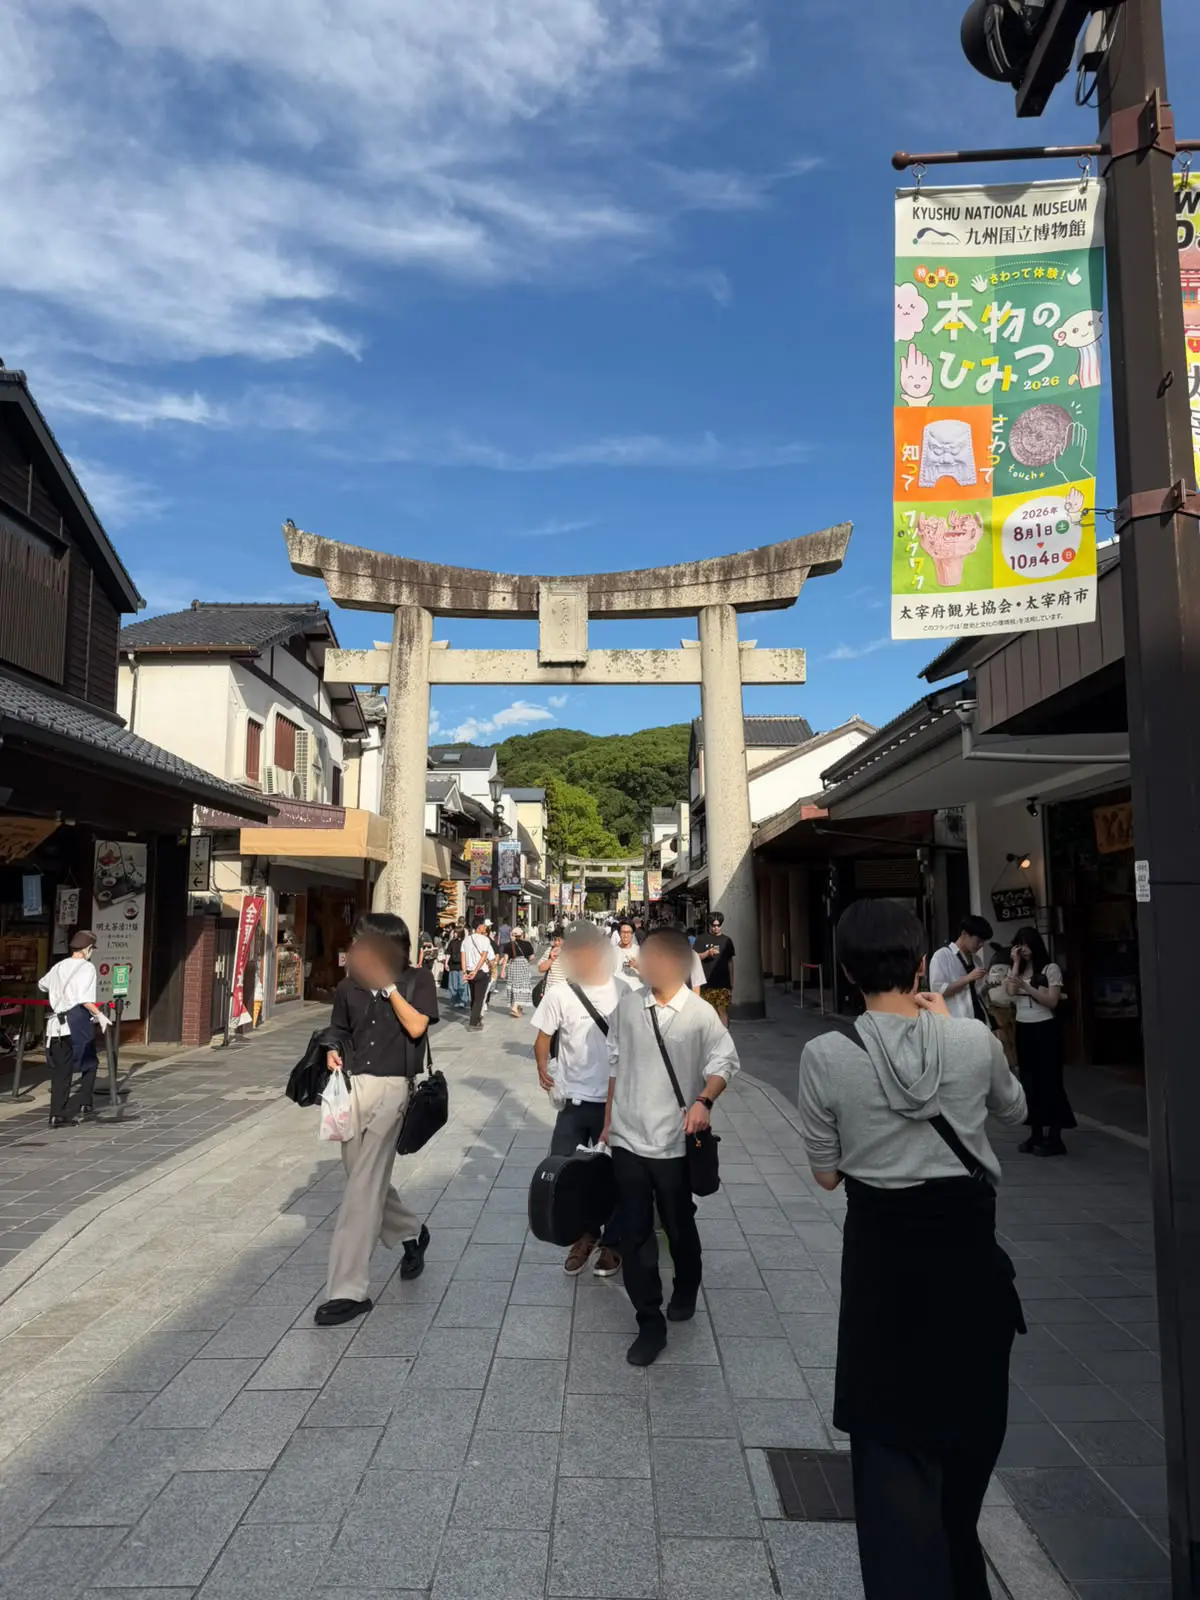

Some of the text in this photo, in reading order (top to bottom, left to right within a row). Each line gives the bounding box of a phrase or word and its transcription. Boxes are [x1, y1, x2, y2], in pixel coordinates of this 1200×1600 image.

[912, 198, 1088, 221] KYUSHU NATIONAL MUSEUM
[964, 219, 1086, 246] 九州国立博物館
[931, 292, 1061, 344] 本物の
[939, 344, 1054, 394] ひみつ
[1023, 376, 1060, 391] 2026
[979, 414, 1009, 484] さわって
[901, 443, 920, 491] 知って
[1021, 507, 1058, 520] 2026年
[1013, 523, 1053, 542] 8月1日
[1010, 551, 1060, 571] 10月4日
